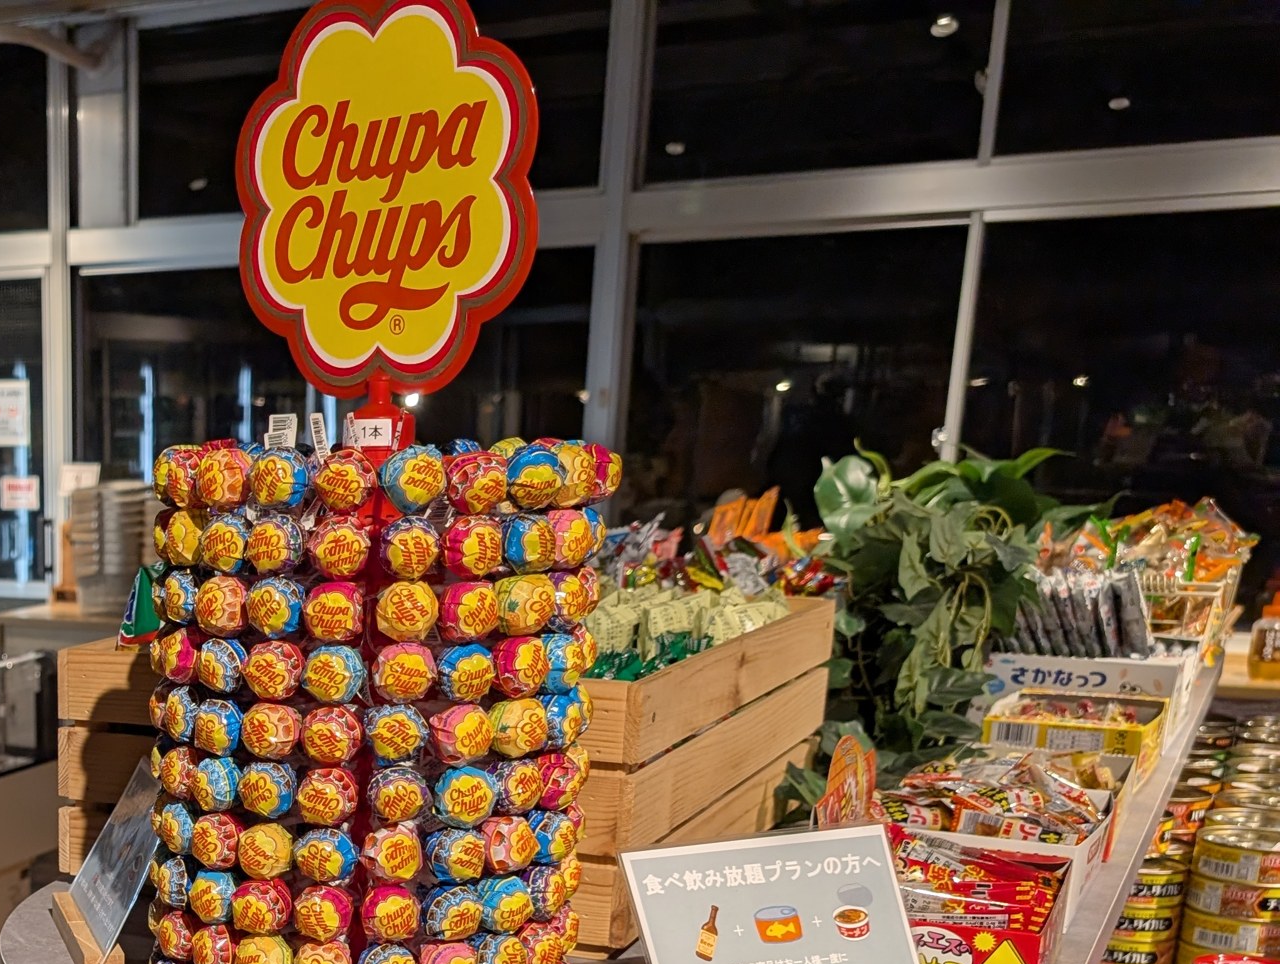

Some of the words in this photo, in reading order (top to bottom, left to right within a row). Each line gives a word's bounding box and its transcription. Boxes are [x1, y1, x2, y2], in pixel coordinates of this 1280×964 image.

[282, 99, 487, 203] Chupa
[275, 189, 478, 330] Chups
[361, 425, 383, 439] 1本
[313, 602, 350, 618] Chupa
[390, 593, 419, 627] Chups
[400, 588, 430, 618] Chupa
[464, 592, 488, 625] Chupa
[310, 615, 348, 636] Chups
[389, 662, 428, 678] Chupa
[1010, 666, 1108, 688] さかなっつ
[385, 673, 423, 694] Chups
[450, 781, 482, 800] Chupa
[452, 792, 488, 816] Chups
[642, 853, 881, 896] 食べ飲み放題プランの方へ
[839, 925, 869, 938] ラーメン
[914, 930, 972, 955] エスの
